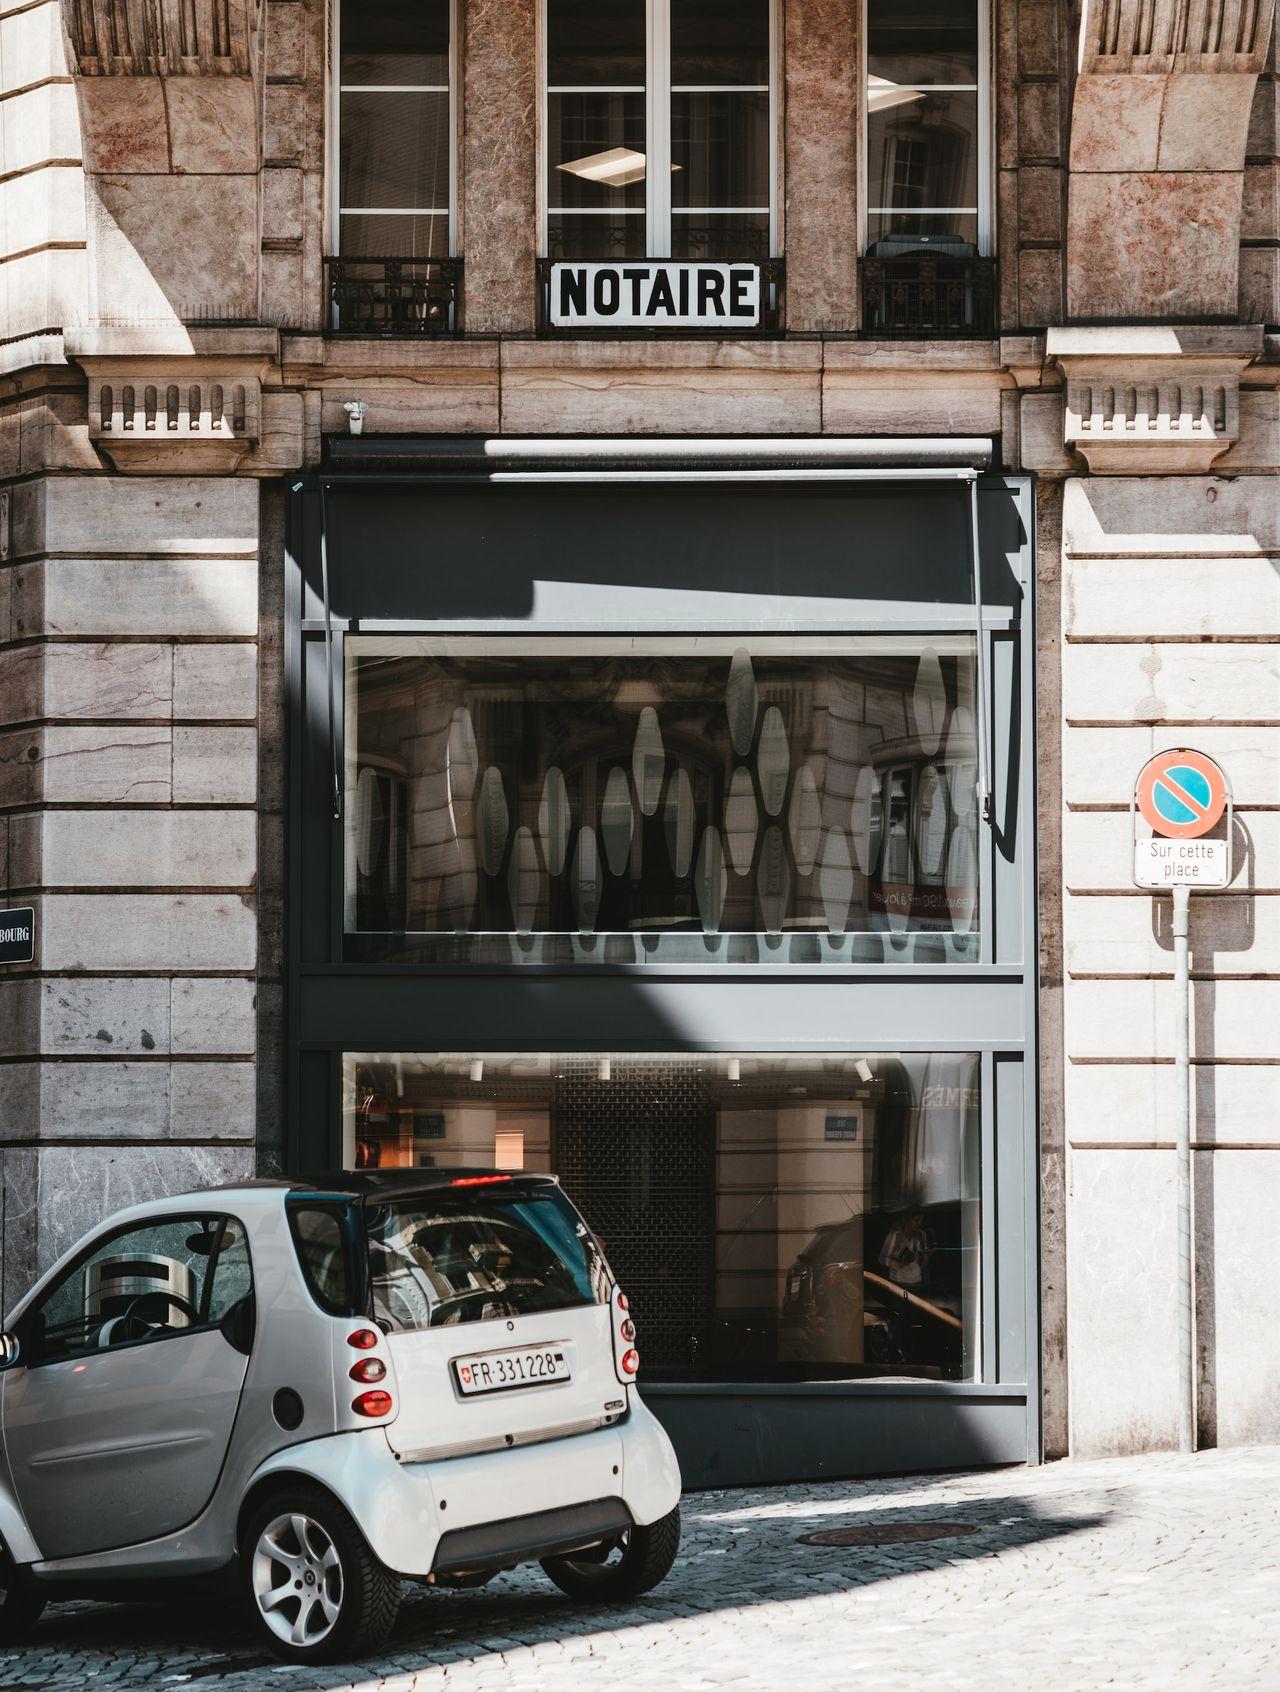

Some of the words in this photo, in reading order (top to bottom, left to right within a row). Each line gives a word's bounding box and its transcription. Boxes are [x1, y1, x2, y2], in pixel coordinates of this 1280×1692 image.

[560, 268, 755, 317] NOTAIRE
[1150, 842, 1172, 858] Sur
[1179, 843, 1214, 859] cette
[1164, 861, 1199, 880] place
